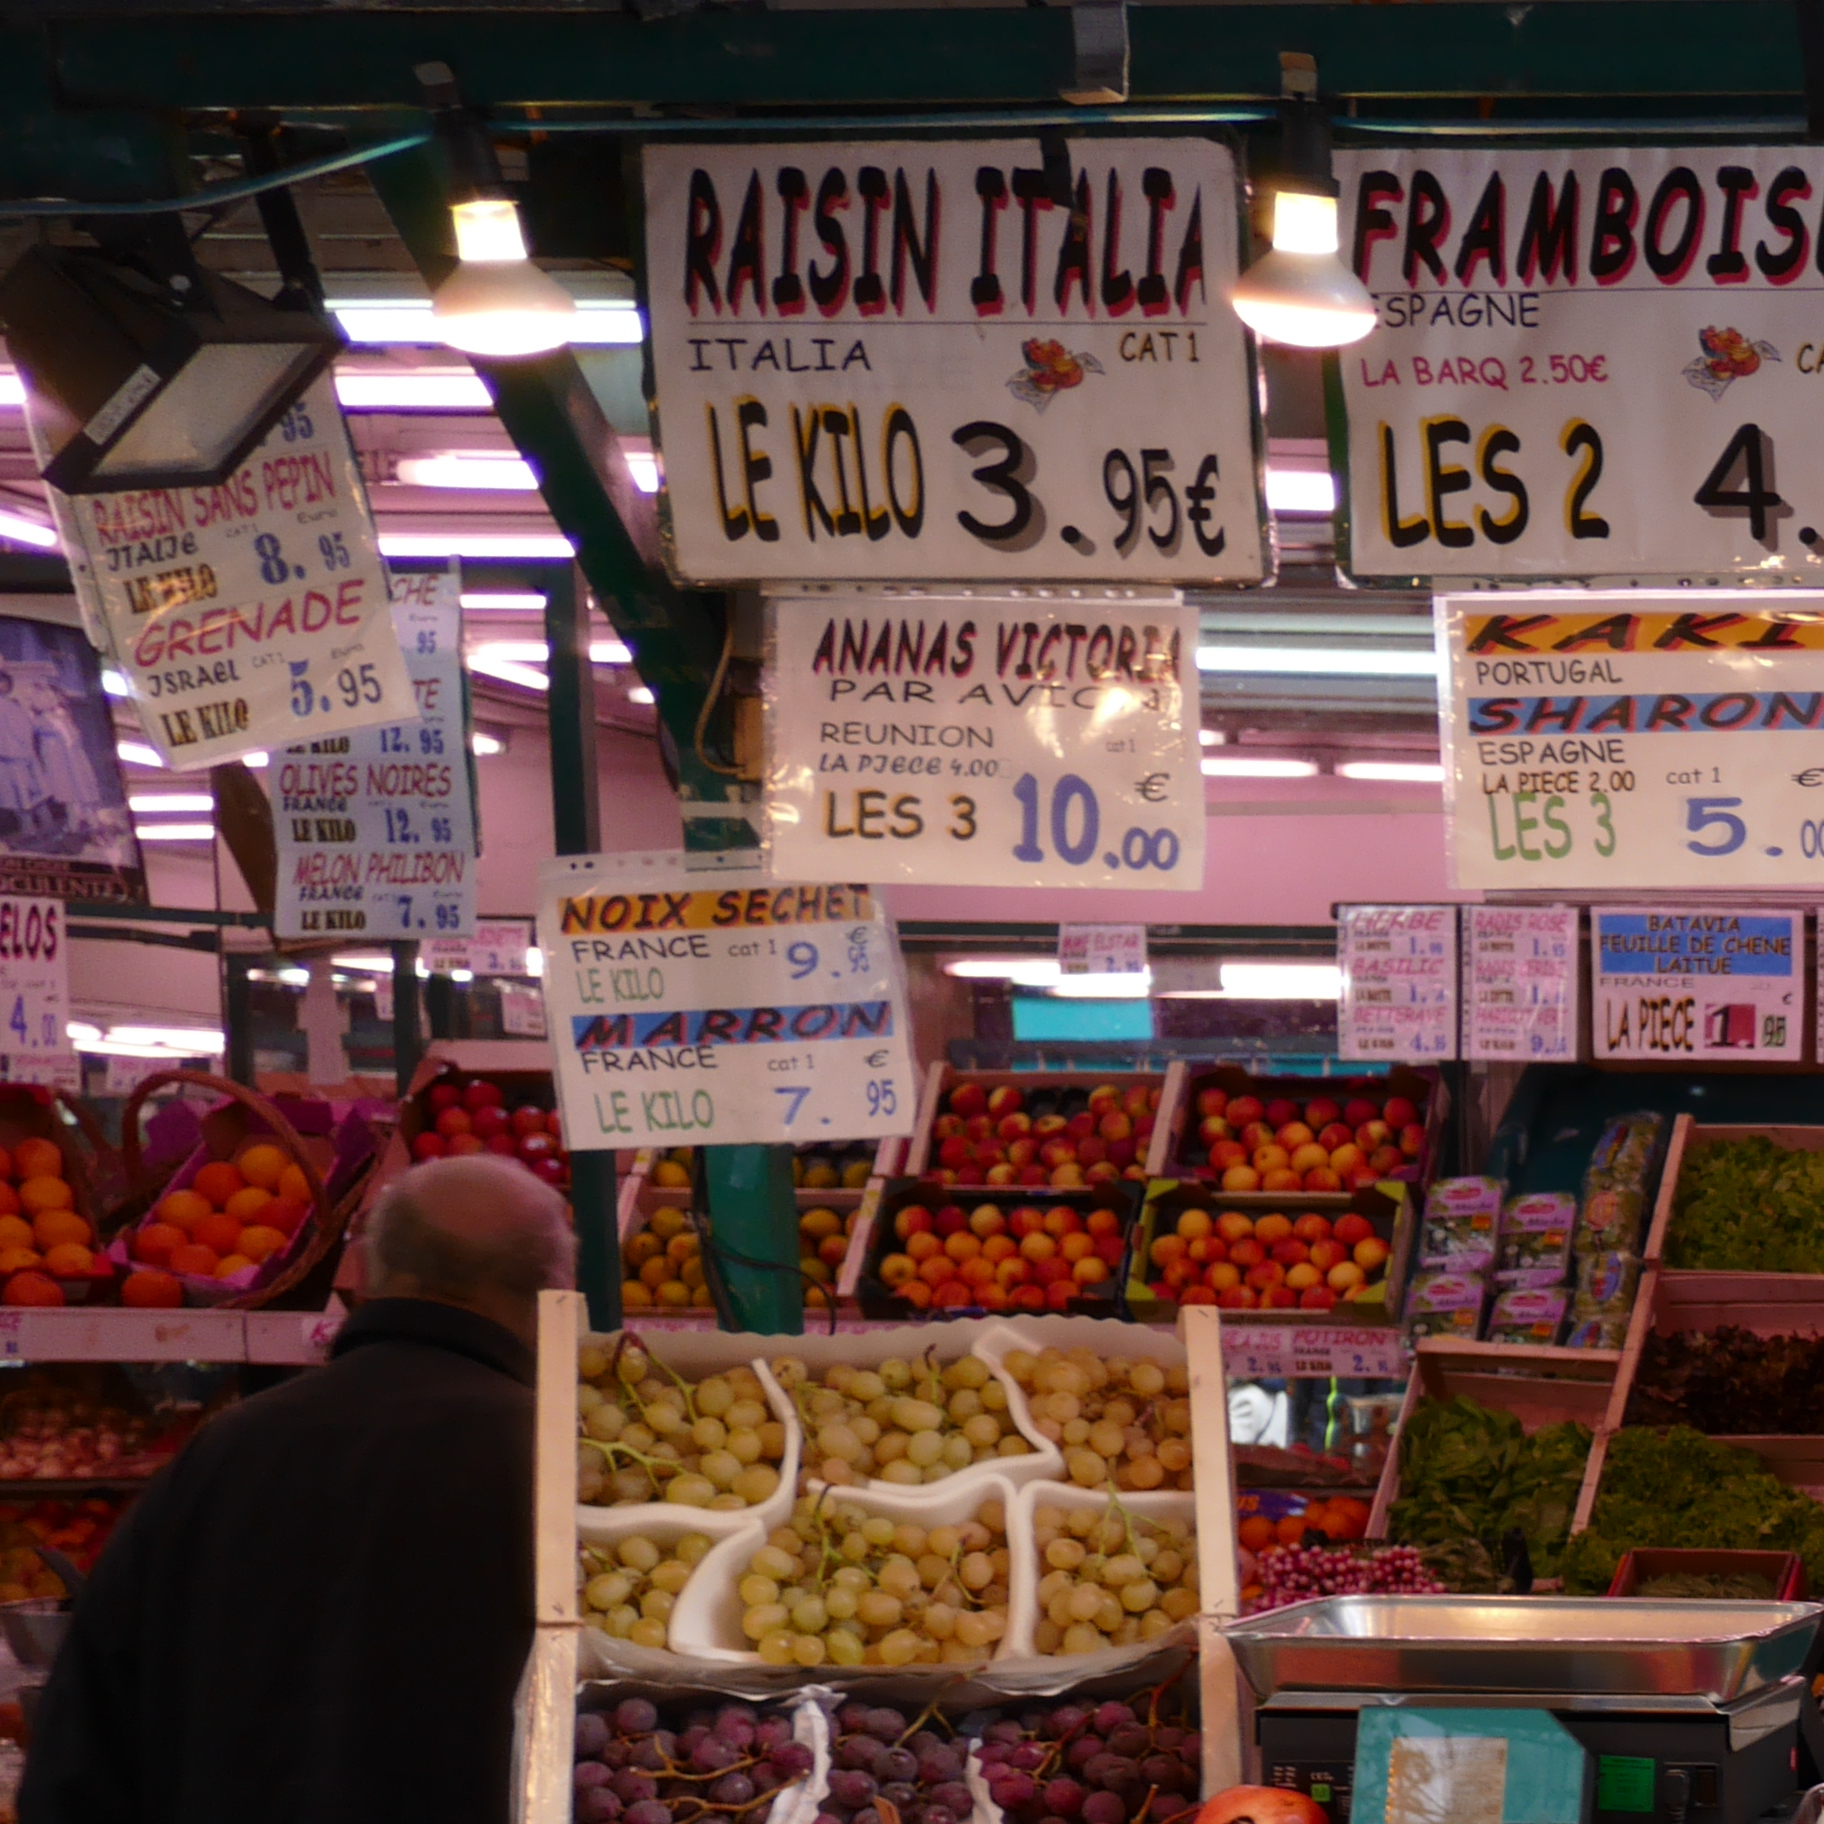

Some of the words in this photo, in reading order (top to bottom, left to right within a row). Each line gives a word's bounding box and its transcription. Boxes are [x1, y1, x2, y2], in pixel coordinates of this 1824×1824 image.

[684, 167, 941, 318] RAISIN
[972, 166, 1206, 319] ITALIA
[689, 339, 872, 372] ITALIA
[1361, 358, 1400, 388] LA
[1415, 356, 1508, 392] BARQ
[1521, 354, 1609, 385] 2.50€
[706, 393, 779, 541] LE
[790, 401, 925, 541] KILO
[1378, 413, 1530, 548] LES
[1559, 415, 1610, 540] 2
[93, 489, 187, 546] RAISIN
[195, 469, 259, 530] SANS
[262, 451, 335, 512] PEPIN
[134, 579, 365, 667] GRENADE
[1467, 612, 1822, 654] KAKI
[812, 618, 978, 678] ANANAS
[997, 621, 1181, 683] VICTORIA
[1476, 659, 1623, 686] PORTUGAL
[830, 680, 935, 703] PAR
[161, 712, 193, 746] LE
[198, 698, 249, 741] KILO
[821, 722, 994, 749] REUNION
[819, 754, 847, 774] LA
[1478, 739, 1625, 766] ESPAGNE
[280, 764, 358, 796] OLIVES
[366, 763, 452, 796] NOIRES
[1482, 771, 1508, 795] LA
[1519, 771, 1580, 794] PIECE
[1589, 770, 1636, 793] 2.00
[283, 796, 348, 812] FRANCE
[823, 790, 924, 839] LES
[948, 793, 978, 840] 3
[1012, 772, 1180, 871] 10.00
[1487, 792, 1573, 862] LES
[1591, 791, 1617, 858] 3
[293, 856, 361, 885] MELON
[368, 853, 465, 886] PHILIBON
[559, 891, 701, 934] NOIX
[711, 882, 872, 926] SECHET
[1647, 915, 1740, 933] BATAVIA
[571, 936, 711, 962] FRANCE
[1601, 935, 1680, 954] FEUILLE
[1687, 935, 1714, 954] DE
[1723, 935, 1790, 956] CHENE
[1351, 958, 1444, 976] BASILIC
[1655, 956, 1732, 975] LAITUE
[1600, 978, 1695, 988] FRANCE
[575, 1001, 891, 1049] MARRON
[1606, 998, 1631, 1052] LA
[1638, 996, 1696, 1052] PIECE
[579, 1045, 719, 1073] FRANCE
[594, 1094, 631, 1136] LE
[642, 1090, 714, 1131] KILO
[1292, 1329, 1387, 1347] POTIRON
